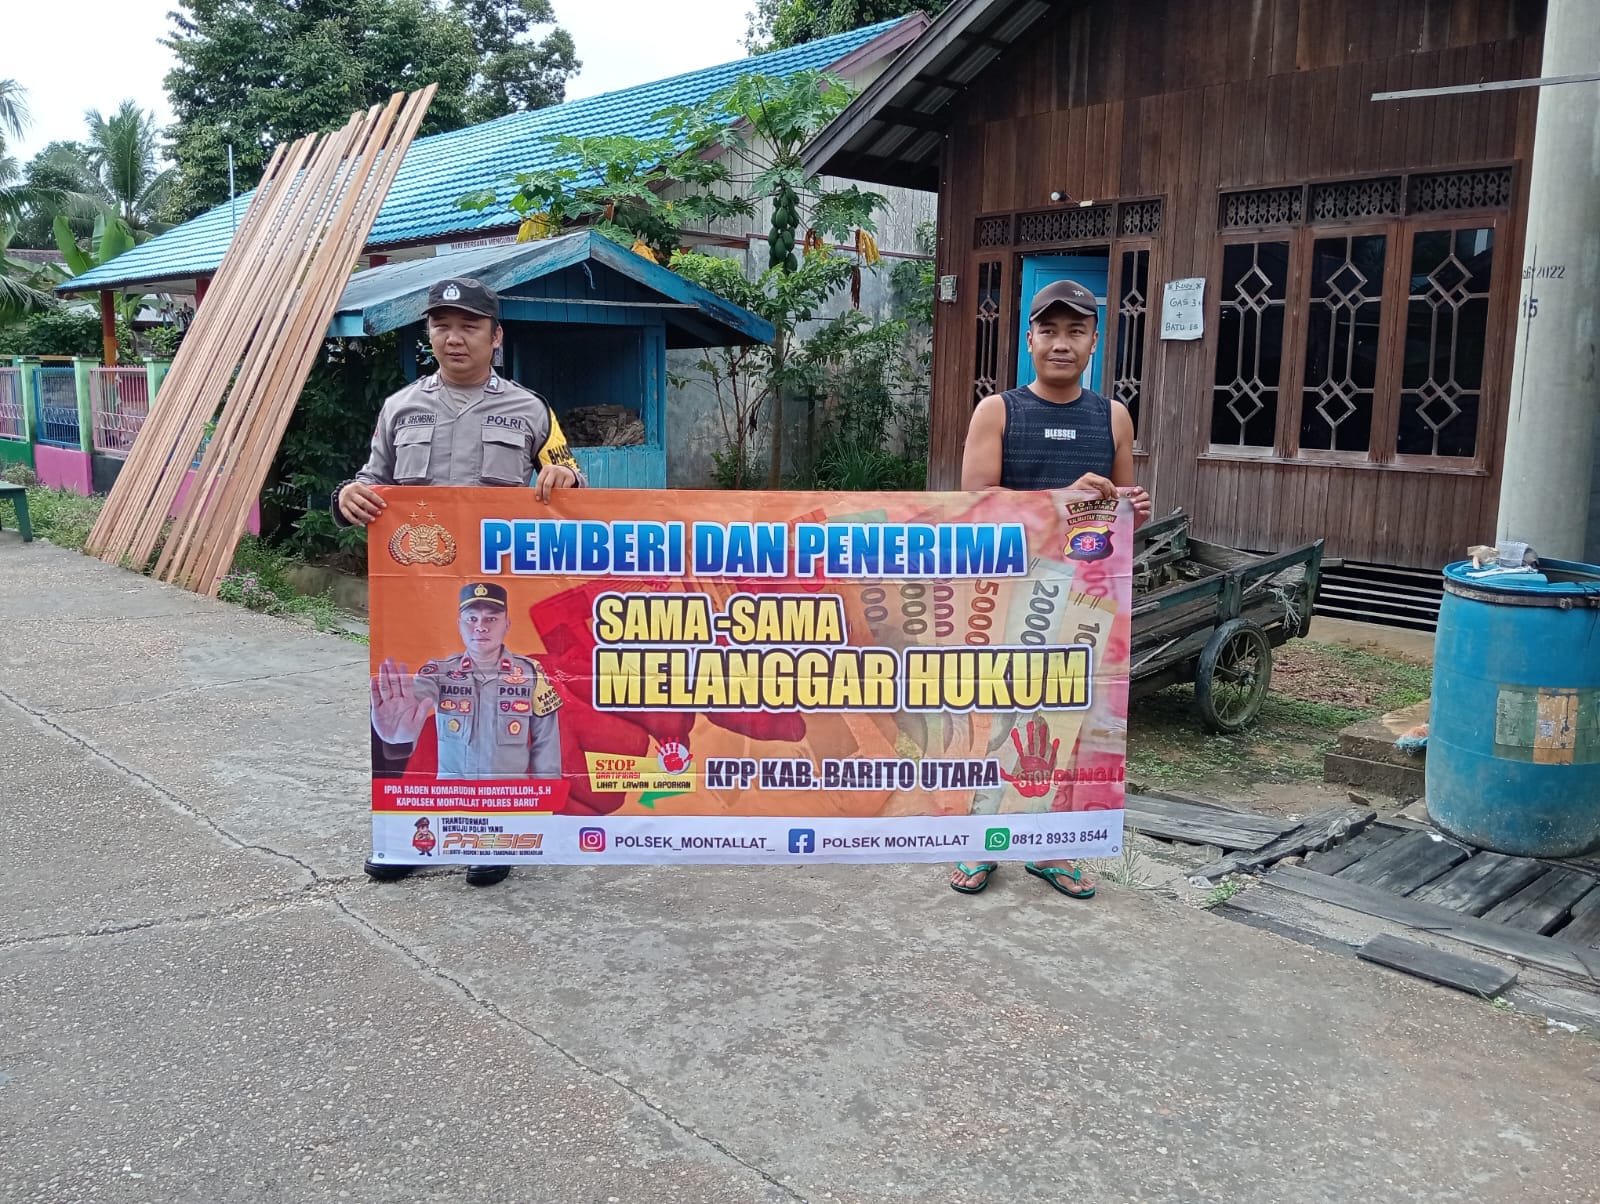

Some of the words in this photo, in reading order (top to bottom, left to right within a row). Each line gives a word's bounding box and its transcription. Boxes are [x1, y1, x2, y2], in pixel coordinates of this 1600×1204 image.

[1169, 297, 1188, 307] GAS
[1522, 298, 1538, 318] 15
[1165, 321, 1185, 331] BATU
[486, 415, 522, 429] POLRI
[1044, 428, 1076, 440] BLESSED
[482, 520, 684, 574] PEMBERI
[695, 522, 787, 575] DAN
[796, 523, 1027, 576] PENERIMA
[596, 594, 845, 645] SAMA-SAMA
[596, 649, 897, 710] MELANGGAR
[905, 649, 1090, 711] HUKUM
[440, 685, 473, 696] RADEN
[499, 686, 531, 697] POLRI
[595, 759, 636, 771] STOP
[706, 760, 755, 788] KPP
[761, 760, 818, 788] KAB.
[823, 761, 915, 789] BARITO
[921, 760, 1000, 788] UTARA
[1053, 766, 1125, 786] PUNGLI
[404, 785, 429, 795] RADEN
[431, 785, 476, 796] KOMARUDIN
[596, 781, 618, 789] LIHAT
[622, 781, 649, 789] LAWAN
[396, 797, 434, 807] KAPOLSEK
[436, 798, 479, 808] MONTALLAT
[481, 798, 511, 808] POLRES
[513, 798, 539, 807] BARUT
[441, 817, 488, 826] TRANSFORMASI
[442, 825, 468, 833] MENUJU
[468, 825, 487, 833] POLRI
[488, 825, 503, 833] YANG
[442, 832, 544, 849] PRESISI
[822, 836, 881, 848] POLSEK
[884, 834, 970, 847] MONTALLAT
[1012, 833, 1043, 845] 0812
[1046, 831, 1076, 844] 8933
[1079, 828, 1108, 842] 8544
[615, 836, 775, 851] POLSEK_MONTALLAT_
